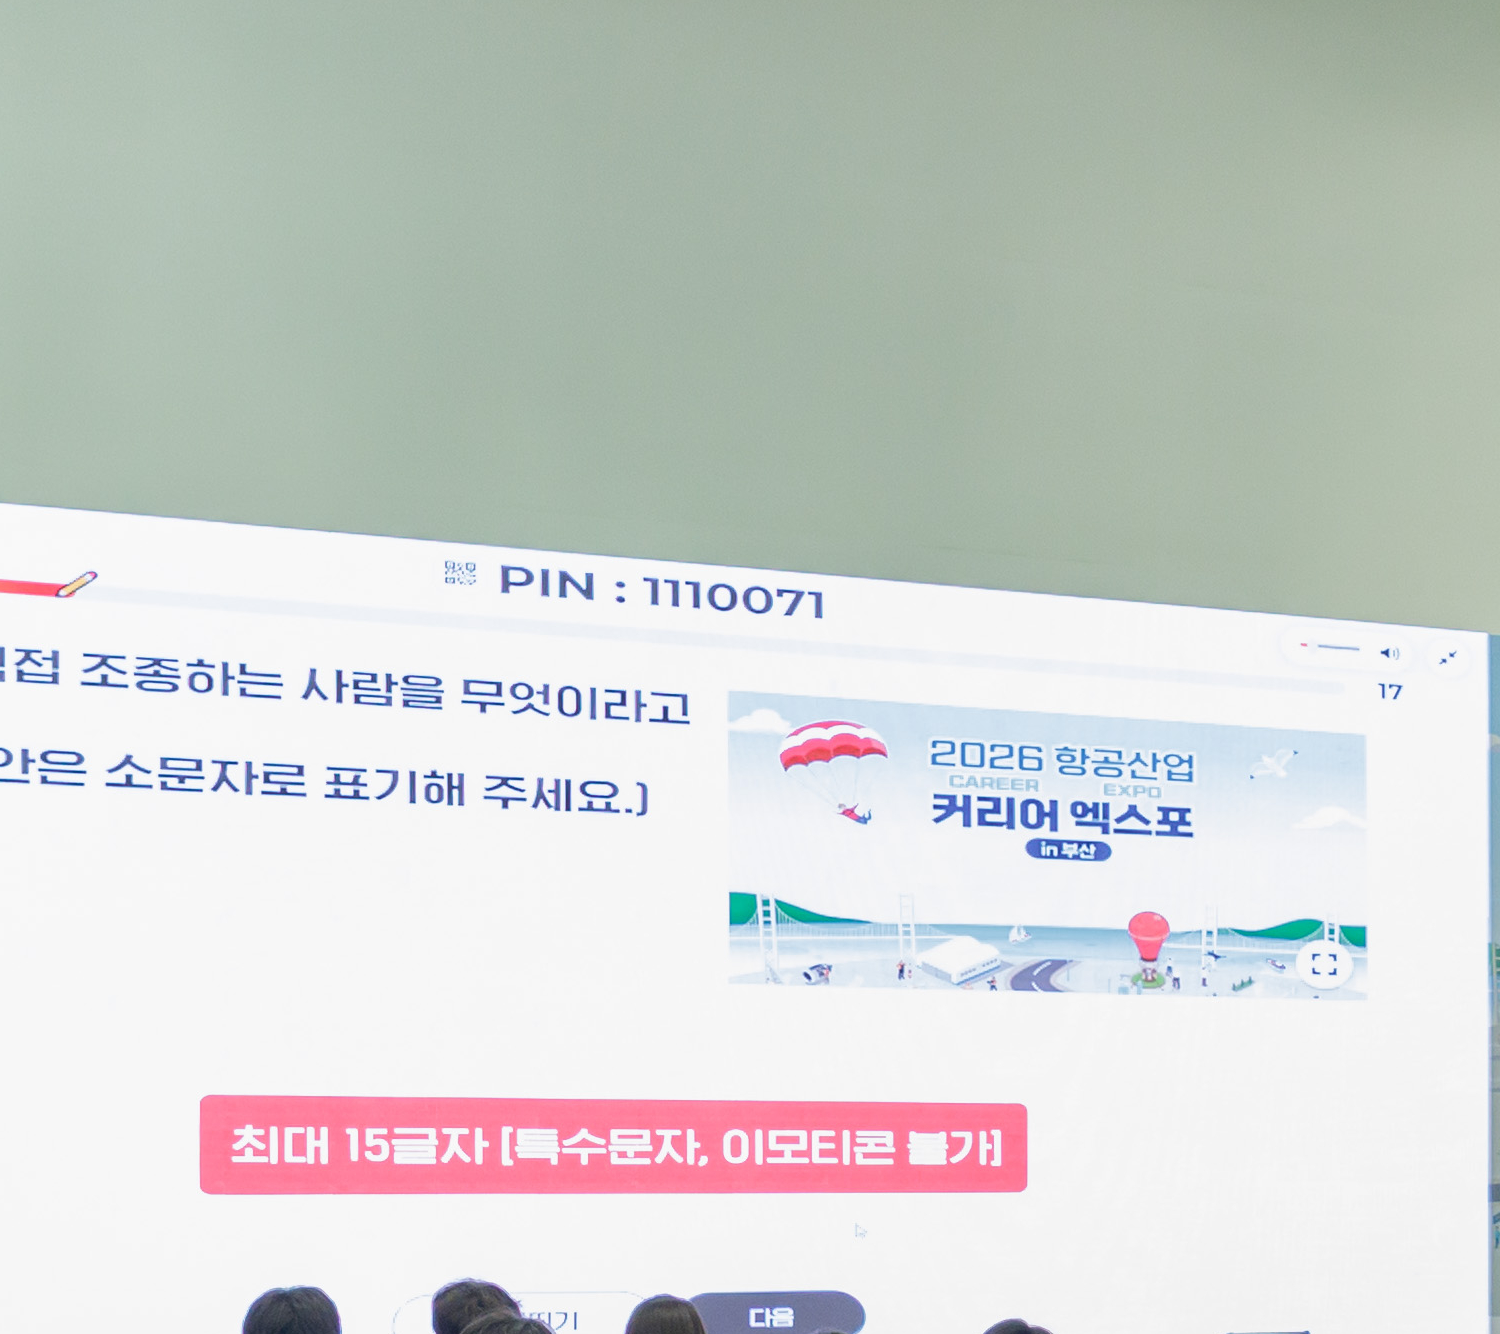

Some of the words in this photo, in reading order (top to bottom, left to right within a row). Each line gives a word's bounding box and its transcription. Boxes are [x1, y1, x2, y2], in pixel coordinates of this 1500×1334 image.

[500, 563, 595, 601] PIN
[642, 576, 824, 620] 1110071
[80, 651, 284, 700] 조종하는
[301, 666, 445, 711] 사람을
[461, 677, 691, 726] 무엇이라고
[1377, 681, 1404, 701] 17
[104, 753, 308, 798] 소문자로
[324, 765, 466, 807] 표기해
[930, 739, 1045, 773] 2026
[1053, 745, 1195, 784] 항공산업
[948, 774, 1040, 793] CAREER
[1102, 782, 1162, 799] EXPO
[931, 792, 1059, 833] 커리어
[1069, 799, 1195, 838] 엑스포
[1039, 840, 1059, 857] in
[1060, 841, 1098, 860] 부산
[230, 1123, 330, 1166] 최대
[345, 1126, 491, 1166] 15글자
[722, 1127, 897, 1167] 이모티콘
[747, 1305, 796, 1330] 다음
